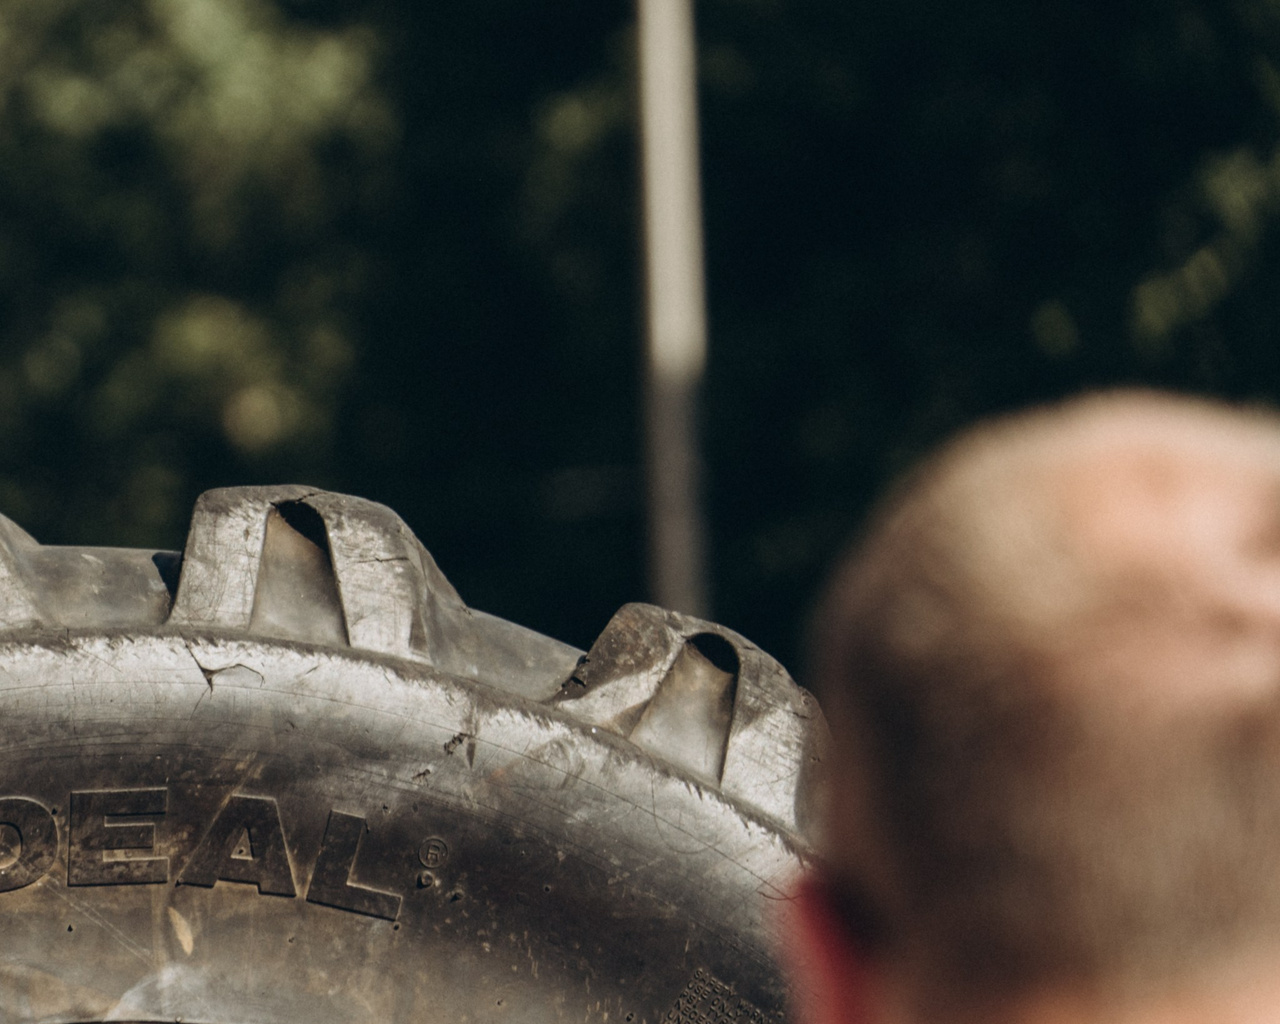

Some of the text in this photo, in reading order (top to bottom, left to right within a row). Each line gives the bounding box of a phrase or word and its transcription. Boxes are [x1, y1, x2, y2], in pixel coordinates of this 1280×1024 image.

[687, 980, 711, 1000] USE
[711, 997, 741, 1021] ONLY
[694, 967, 736, 1001] SAFETY
